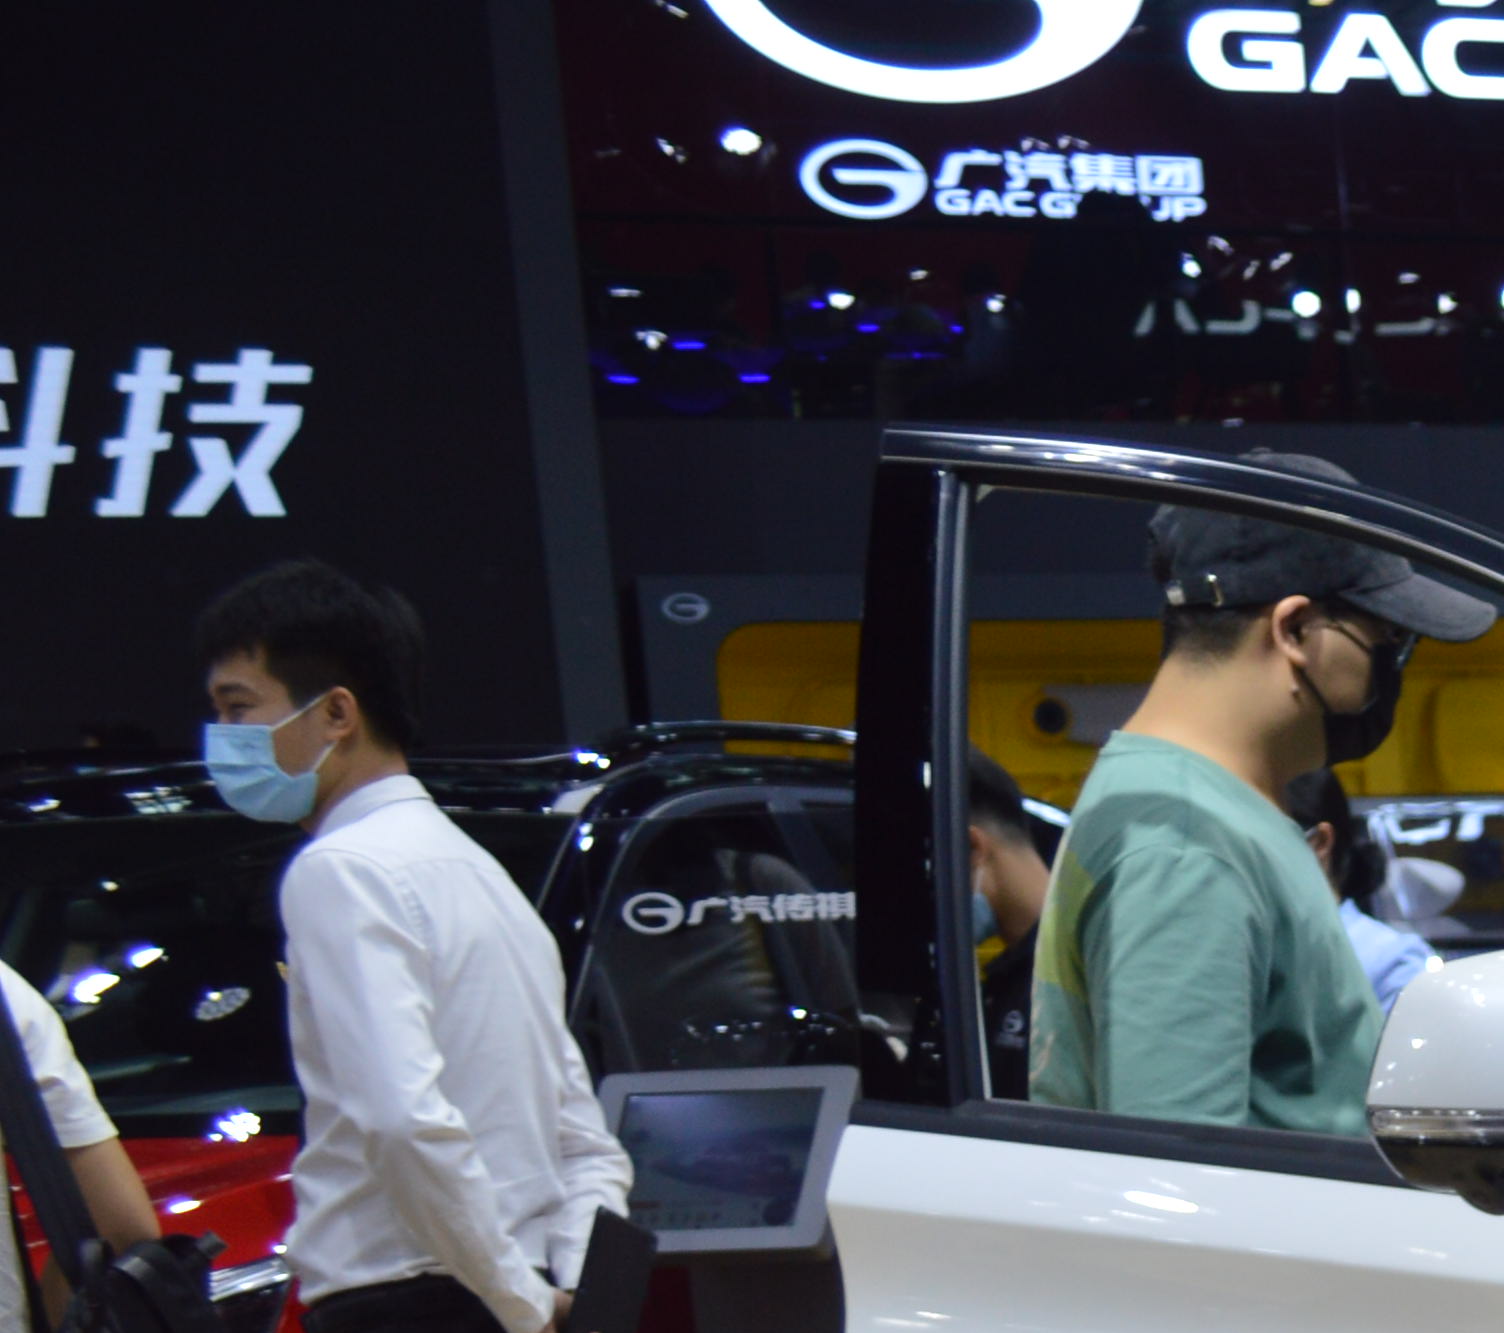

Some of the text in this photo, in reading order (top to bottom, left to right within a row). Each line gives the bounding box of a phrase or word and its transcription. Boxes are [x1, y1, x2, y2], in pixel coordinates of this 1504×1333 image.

[934, 149, 1204, 197] 广汽集团
[934, 188, 1208, 223] GAC GUP
